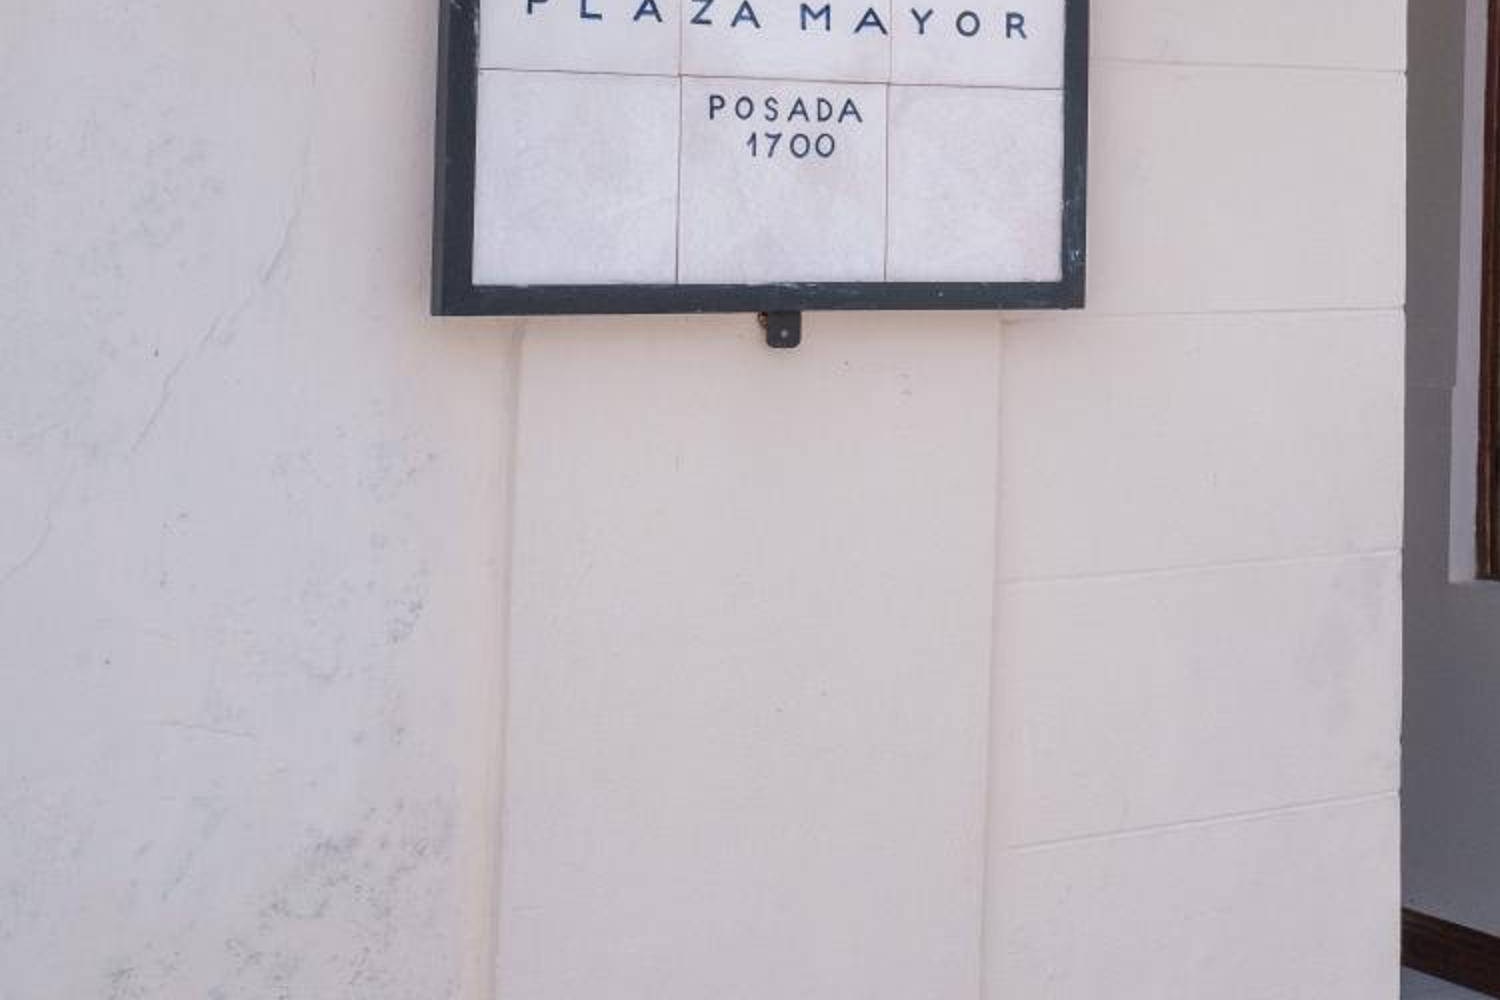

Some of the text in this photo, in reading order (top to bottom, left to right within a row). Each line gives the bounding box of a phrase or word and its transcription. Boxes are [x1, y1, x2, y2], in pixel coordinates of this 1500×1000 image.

[799, 3, 1027, 39] MAYOR
[708, 94, 863, 123] POSADA
[746, 132, 836, 158] 1700
